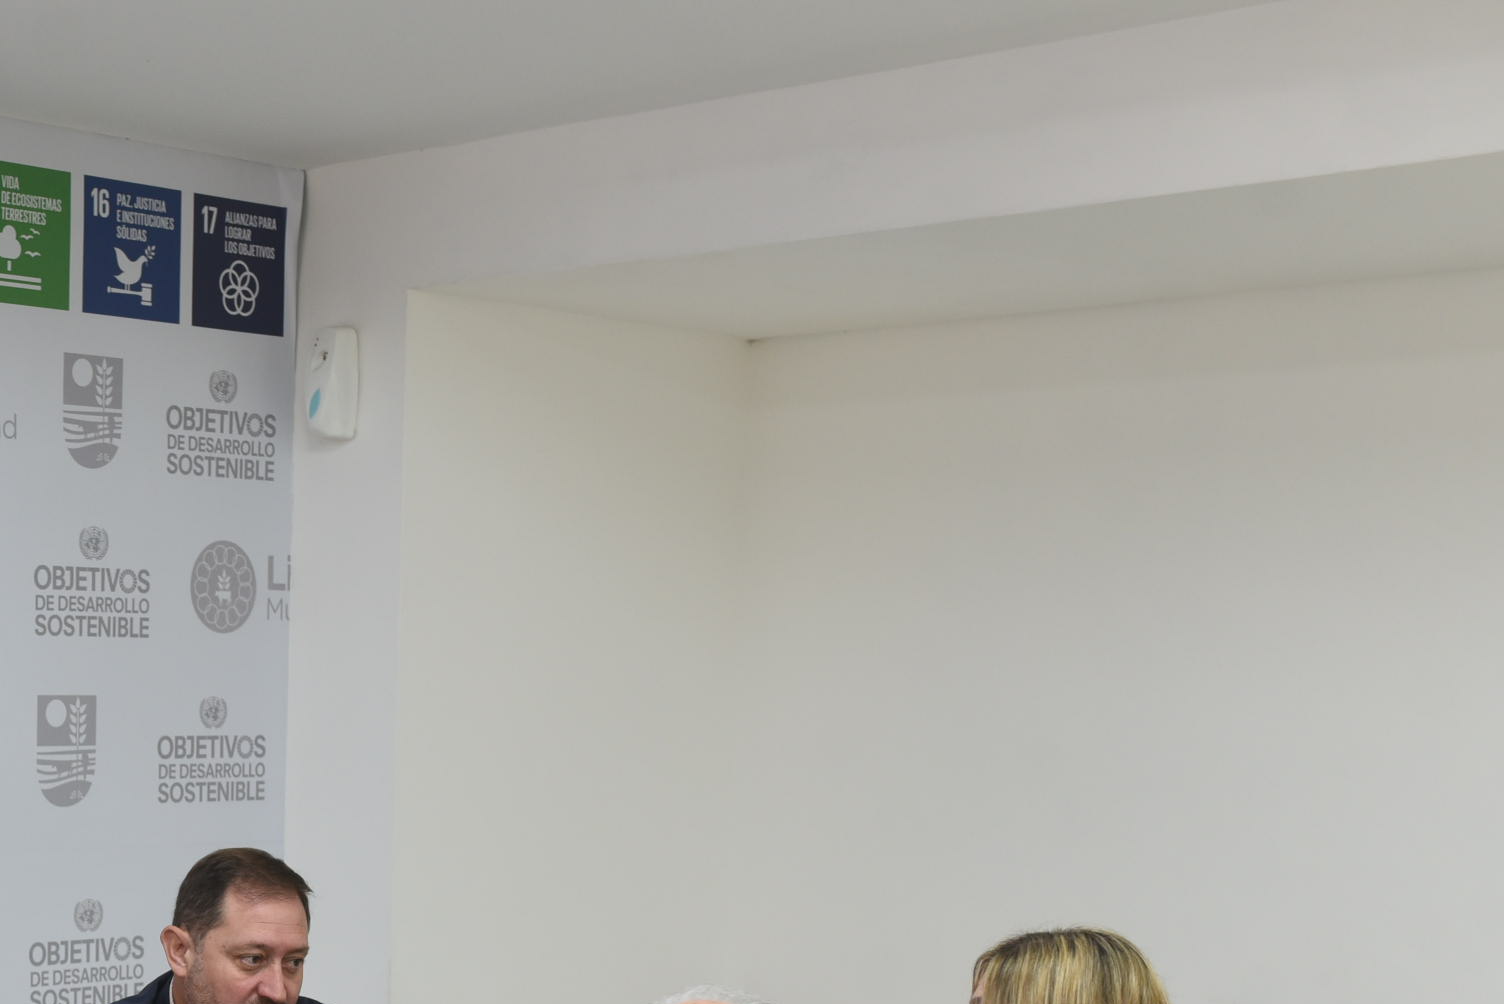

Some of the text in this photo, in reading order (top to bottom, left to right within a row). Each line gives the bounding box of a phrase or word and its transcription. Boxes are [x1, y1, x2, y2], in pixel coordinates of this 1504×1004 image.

[1, 174, 20, 190] VIDA
[1, 190, 62, 212] DE ECOSISTEMAS
[91, 187, 110, 218] 16
[134, 196, 166, 213] JUSTICIA
[1, 206, 47, 226] TERRESTRES
[116, 209, 175, 230] E INSTITUCIONES
[201, 205, 218, 234] 17
[225, 211, 277, 231] ALIANZAS PARA
[116, 225, 147, 242] SÓLIDAS
[225, 225, 252, 241] LOGRAR
[224, 240, 275, 260] LOS OBJETIVOS
[166, 405, 276, 438] OBJETIVOS
[167, 434, 276, 458] DE DESARROLLO
[167, 452, 275, 481] SOSTENIBLE
[34, 564, 150, 594] OBJETIVOS
[35, 594, 150, 614] DE DESARROLLO
[35, 614, 150, 638] SOSTENIBLE
[157, 734, 266, 759] OBJETIVOS
[158, 762, 265, 779] DE DESARROLLO
[158, 781, 265, 803] SOSTENIBLE
[29, 935, 144, 967] OBJETIVOS
[30, 964, 144, 987] DE DESARROLLO
